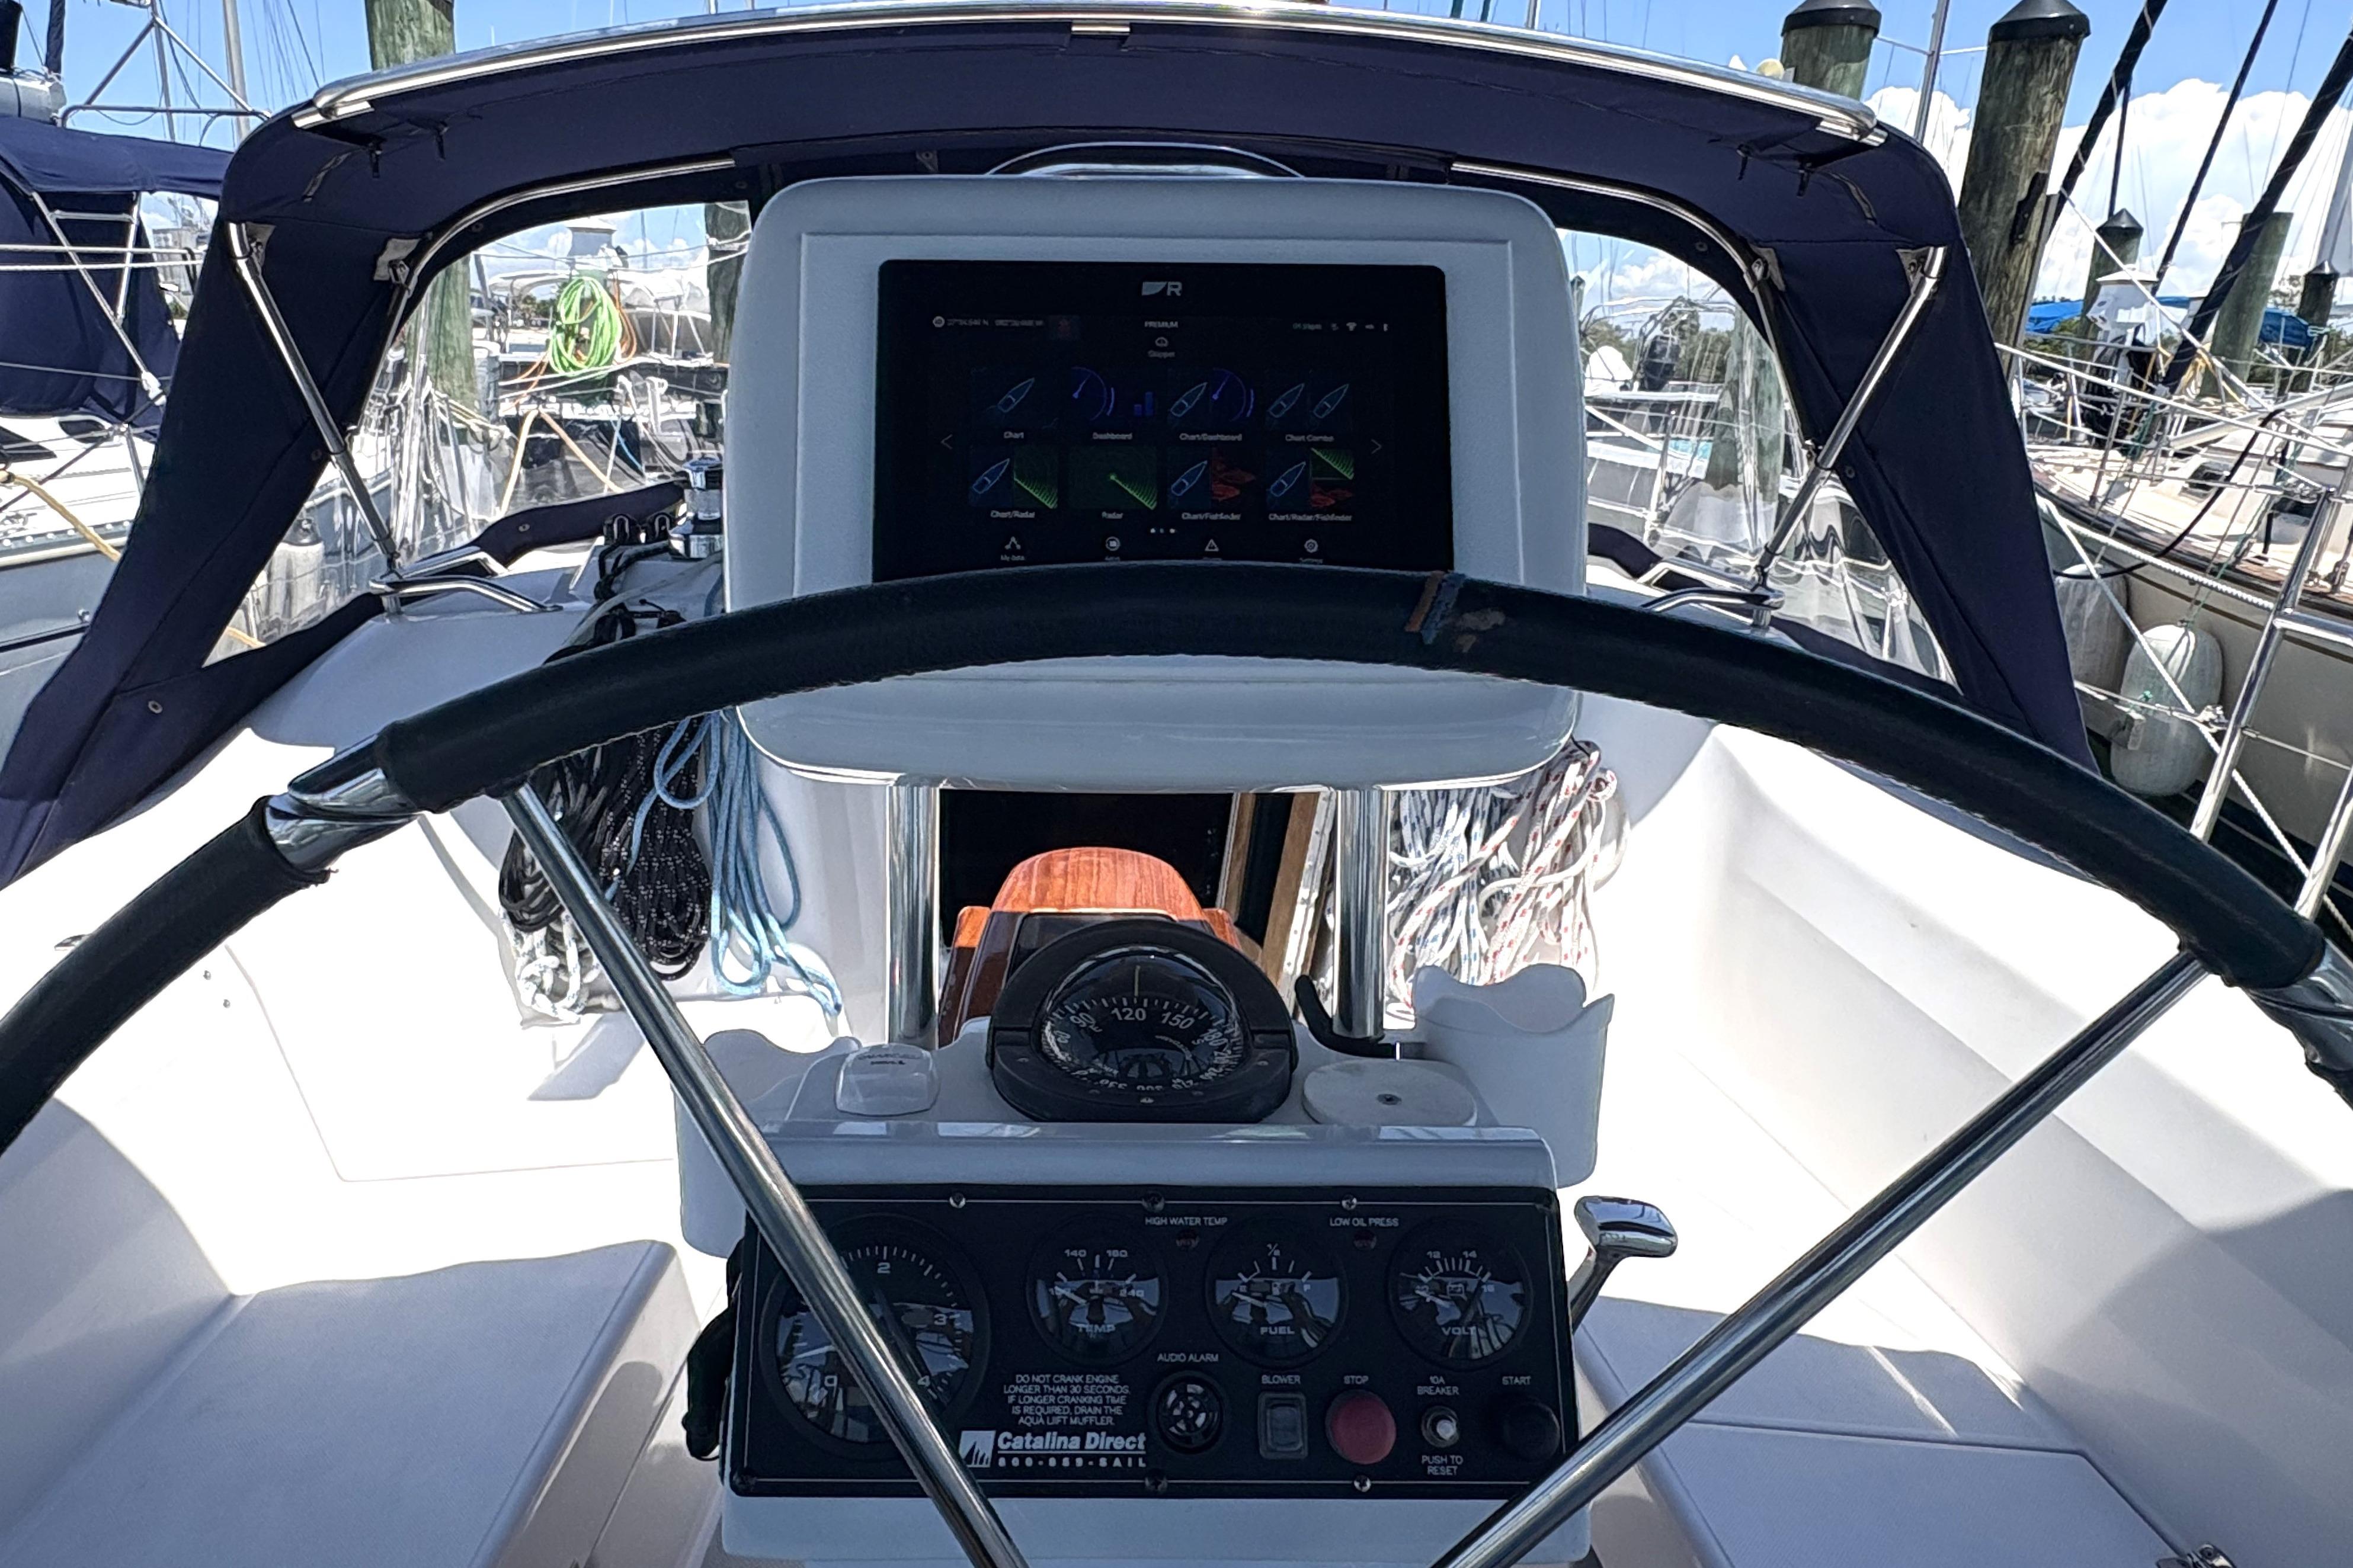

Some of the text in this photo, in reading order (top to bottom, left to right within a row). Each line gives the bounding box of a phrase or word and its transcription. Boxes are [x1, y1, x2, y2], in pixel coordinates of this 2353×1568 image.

[1166, 281, 1183, 296] R
[1111, 1008, 1147, 1021] 120
[1070, 1012, 1096, 1028] 90
[1161, 1011, 1195, 1030] 150
[1199, 1028, 1228, 1047] 180
[1145, 1217, 1228, 1226] HIGH WATER TEMP
[1329, 1217, 1399, 1227] LOW OIL PRESS
[1064, 1249, 1087, 1258] 140
[1462, 1250, 1477, 1258] 14
[877, 1262, 891, 1274] 2
[934, 1313, 947, 1326] 3
[1260, 1326, 1295, 1335] FUEL
[1157, 1353, 1219, 1362] AUDIO ALARM
[917, 1375, 931, 1387] 4
[1016, 1374, 1119, 1384] DO NOT CRANK ENGINE
[1261, 1374, 1301, 1385] BLOWER
[1343, 1375, 1369, 1385] STOP
[1429, 1375, 1446, 1386] 10A
[1502, 1375, 1532, 1386] START
[1003, 1384, 1041, 1394] LONGER
[1043, 1384, 1068, 1394] THAN
[1069, 1384, 1081, 1394] 30
[1417, 1386, 1460, 1396] BREAKER
[1007, 1395, 1127, 1405] IF LONGER CRANKING TIME
[1011, 1406, 1022, 1415] IS
[1074, 1406, 1102, 1415] DRAIN
[1104, 1406, 1123, 1415] THE
[1018, 1416, 1045, 1426] AQUA
[1046, 1416, 1068, 1425] LIFT
[997, 1431, 1147, 1450] Catalina Direct
[1422, 1455, 1464, 1465] PUSH TO
[1427, 1466, 1458, 1476] RESET
